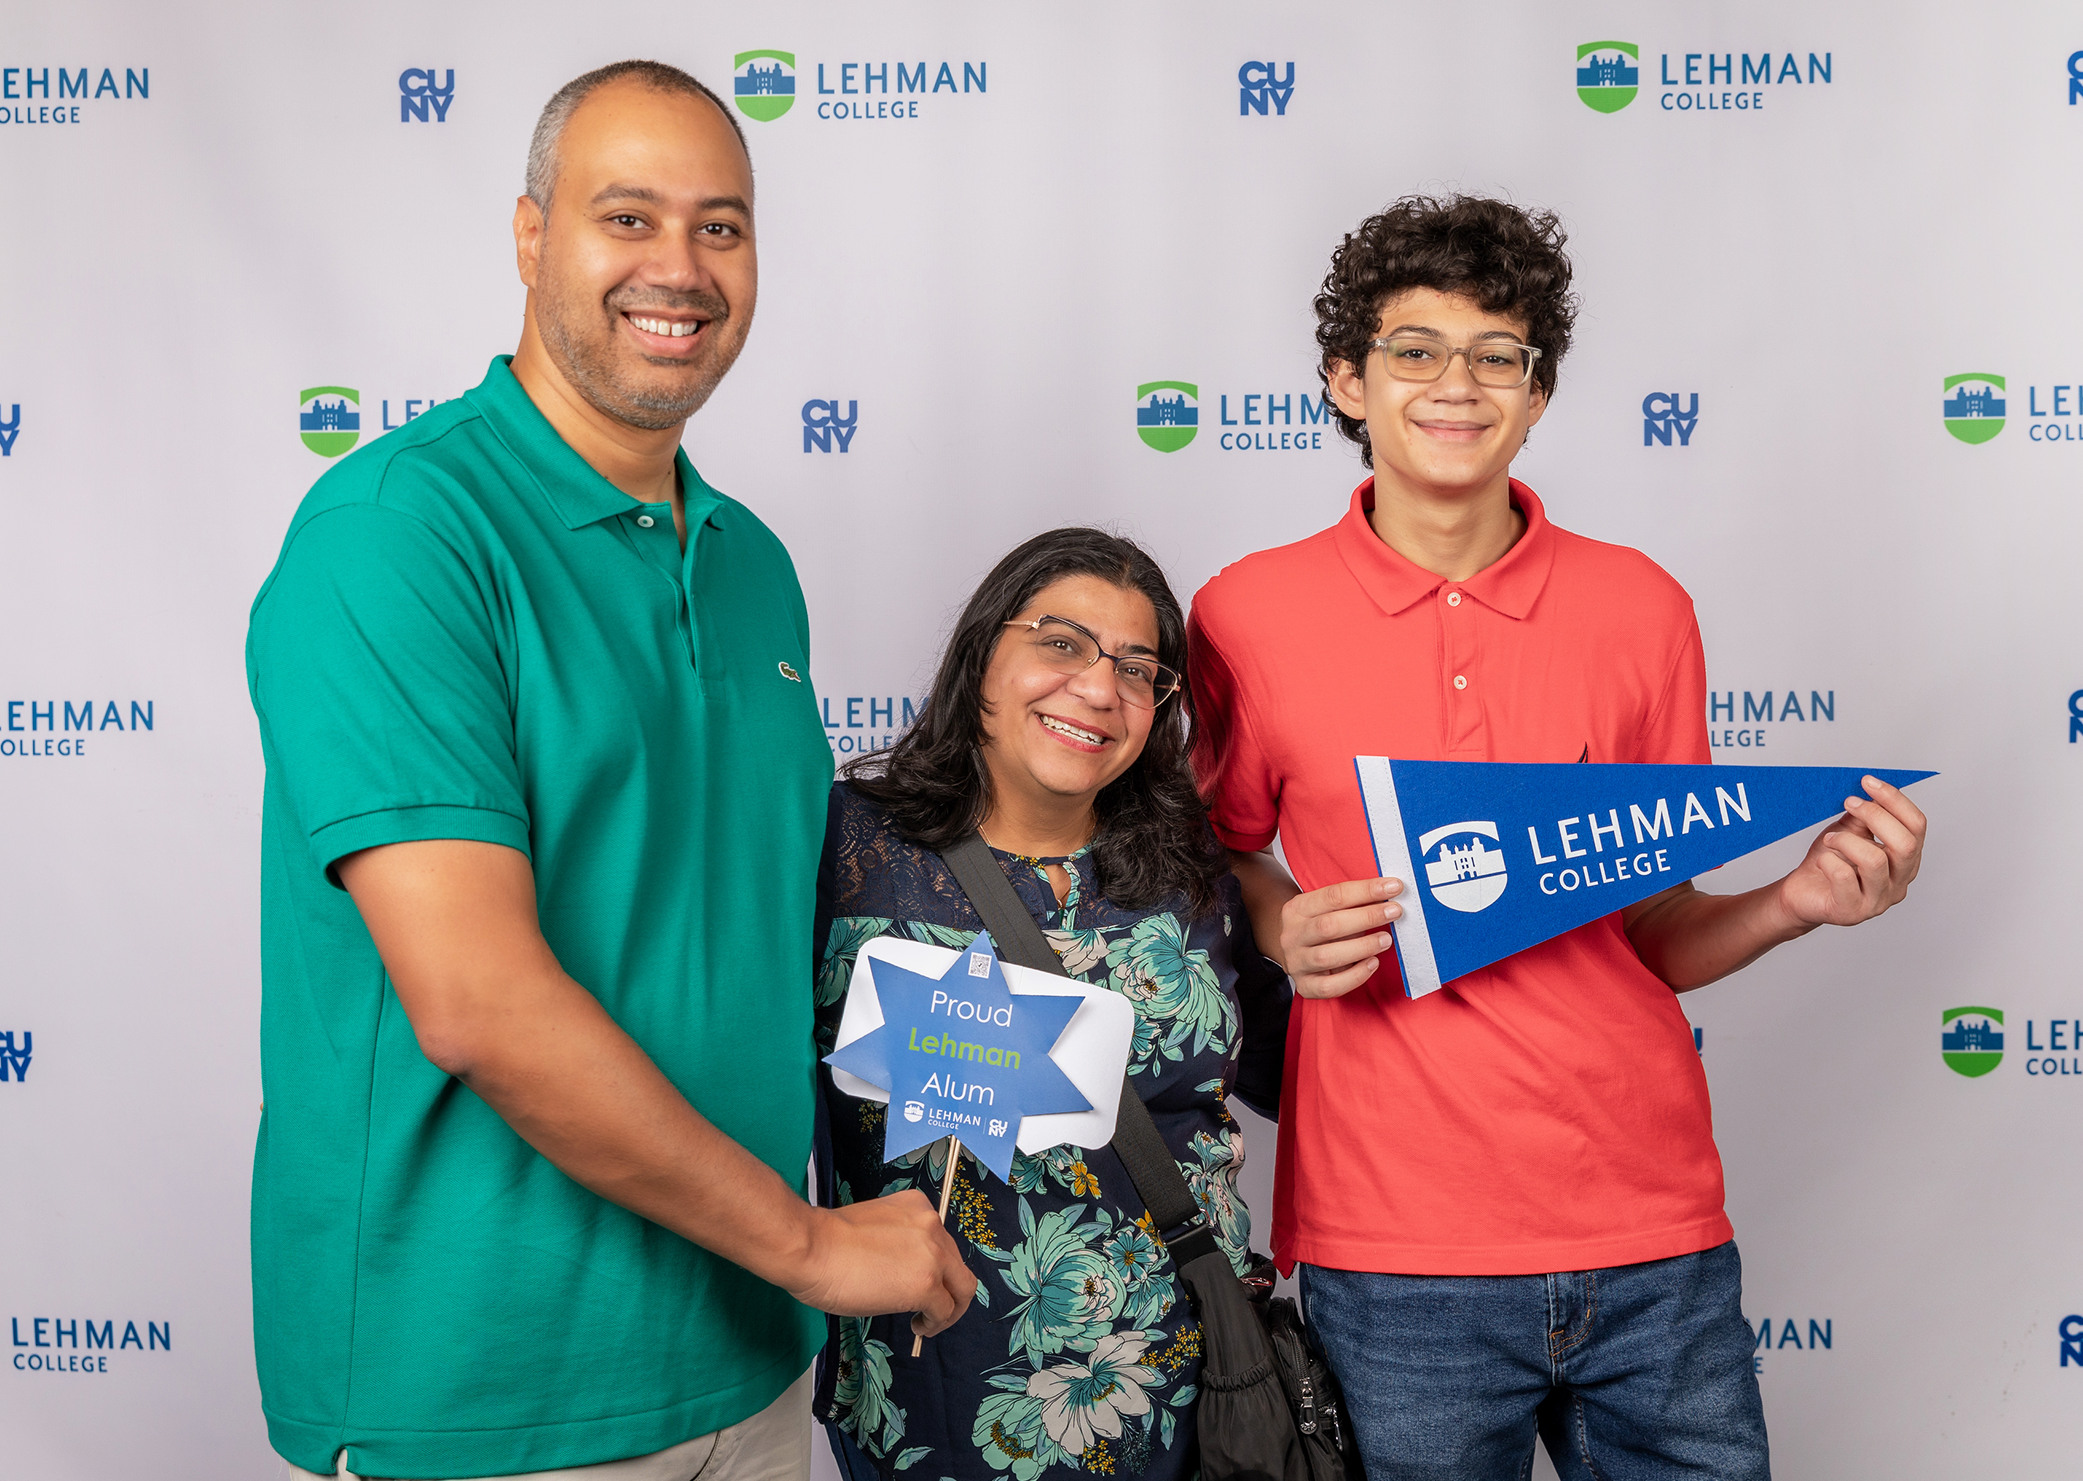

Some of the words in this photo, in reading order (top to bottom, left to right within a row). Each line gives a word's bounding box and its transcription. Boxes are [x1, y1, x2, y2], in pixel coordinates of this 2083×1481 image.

[818, 62, 986, 94] LEHMAN
[1662, 53, 1831, 85] LEHMAN
[4, 68, 148, 99] EHMAN
[818, 101, 918, 119] COLLEGE
[1661, 92, 1762, 110] COLLEGE
[0, 106, 79, 124] OLLEGE
[0, 404, 20, 431] U
[1221, 394, 1333, 425] LEHM
[0, 431, 20, 456] Y
[1221, 432, 1321, 450] COLLEGE
[2030, 424, 2083, 441] COLL
[0, 701, 153, 731] EHMAN
[823, 697, 929, 728] LEHM
[1711, 691, 1833, 722] HMAN
[0, 739, 84, 756] OLLEGE
[1712, 730, 1764, 746] LEGE
[1528, 782, 1752, 865] LEHMAN
[1540, 849, 1671, 895] COLLEGE
[930, 989, 1013, 1028] Proud
[908, 1027, 1021, 1070] Lehman
[2027, 1058, 2082, 1075] COLL
[921, 1072, 994, 1106] Alum
[927, 1119, 959, 1131] COLLEGE
[928, 1108, 982, 1127] LEHMAN
[12, 1317, 170, 1350] LEHMAN
[1752, 1319, 1831, 1350] MAN
[2059, 1315, 2083, 1342] C
[14, 1354, 107, 1372] COLLEGE
[2059, 1342, 2083, 1367] N
